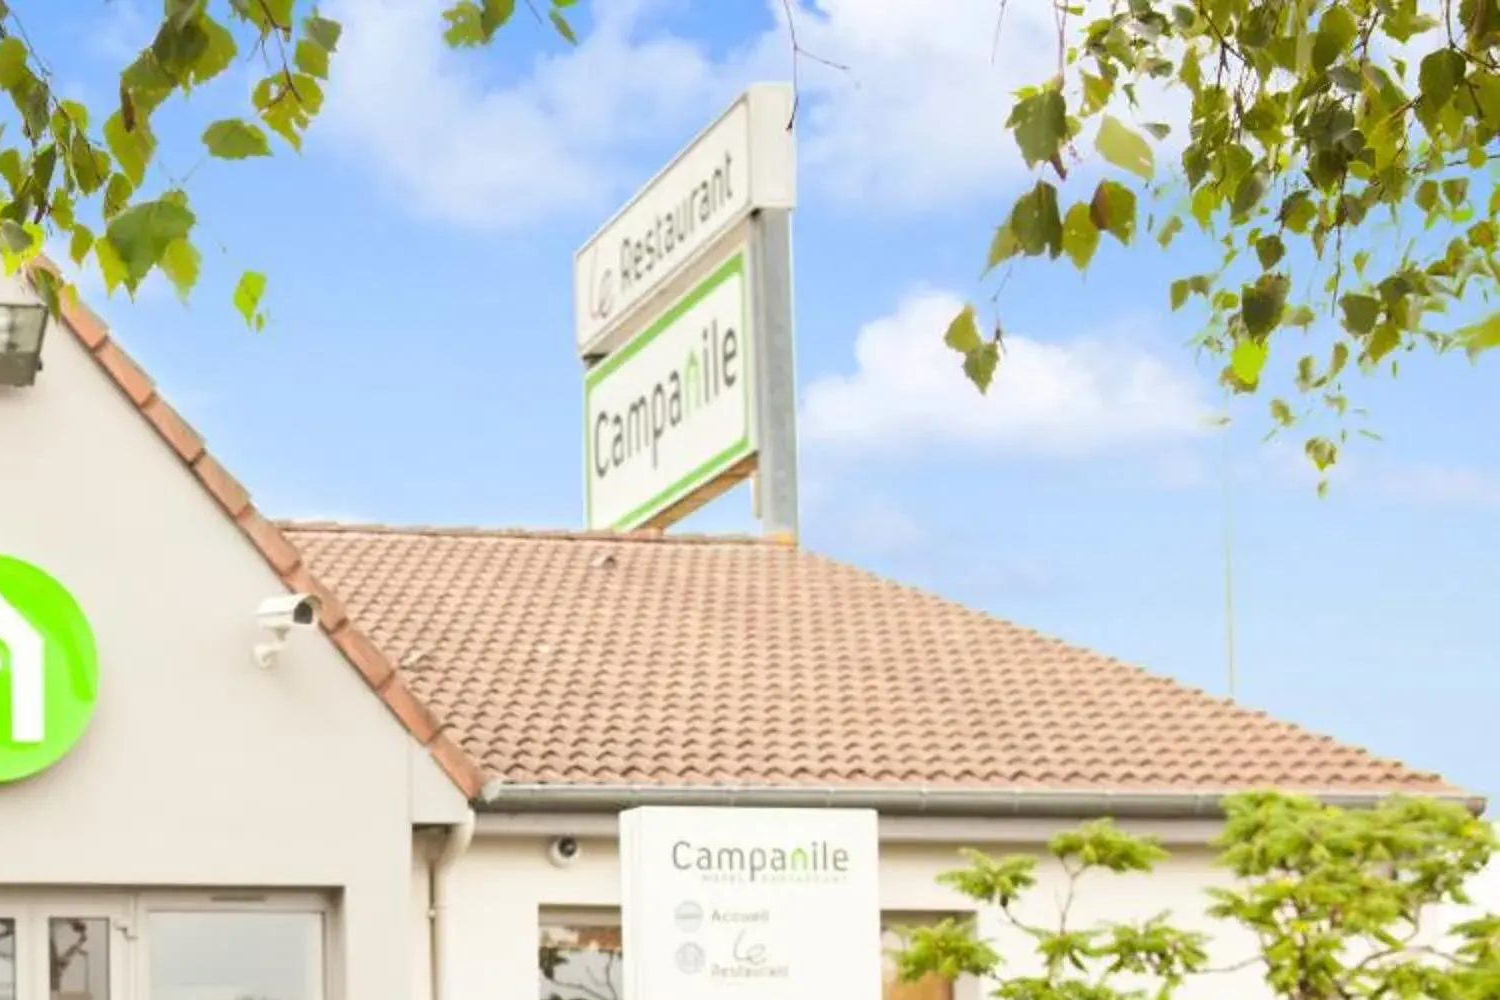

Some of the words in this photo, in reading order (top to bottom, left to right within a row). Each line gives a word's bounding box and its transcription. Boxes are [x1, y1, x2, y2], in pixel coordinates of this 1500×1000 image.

[617, 150, 734, 291] Restaurant
[593, 317, 739, 479] Campanile
[671, 839, 850, 882] Campanile
[710, 908, 770, 923] Accueil
[710, 963, 789, 978] Restaurant
